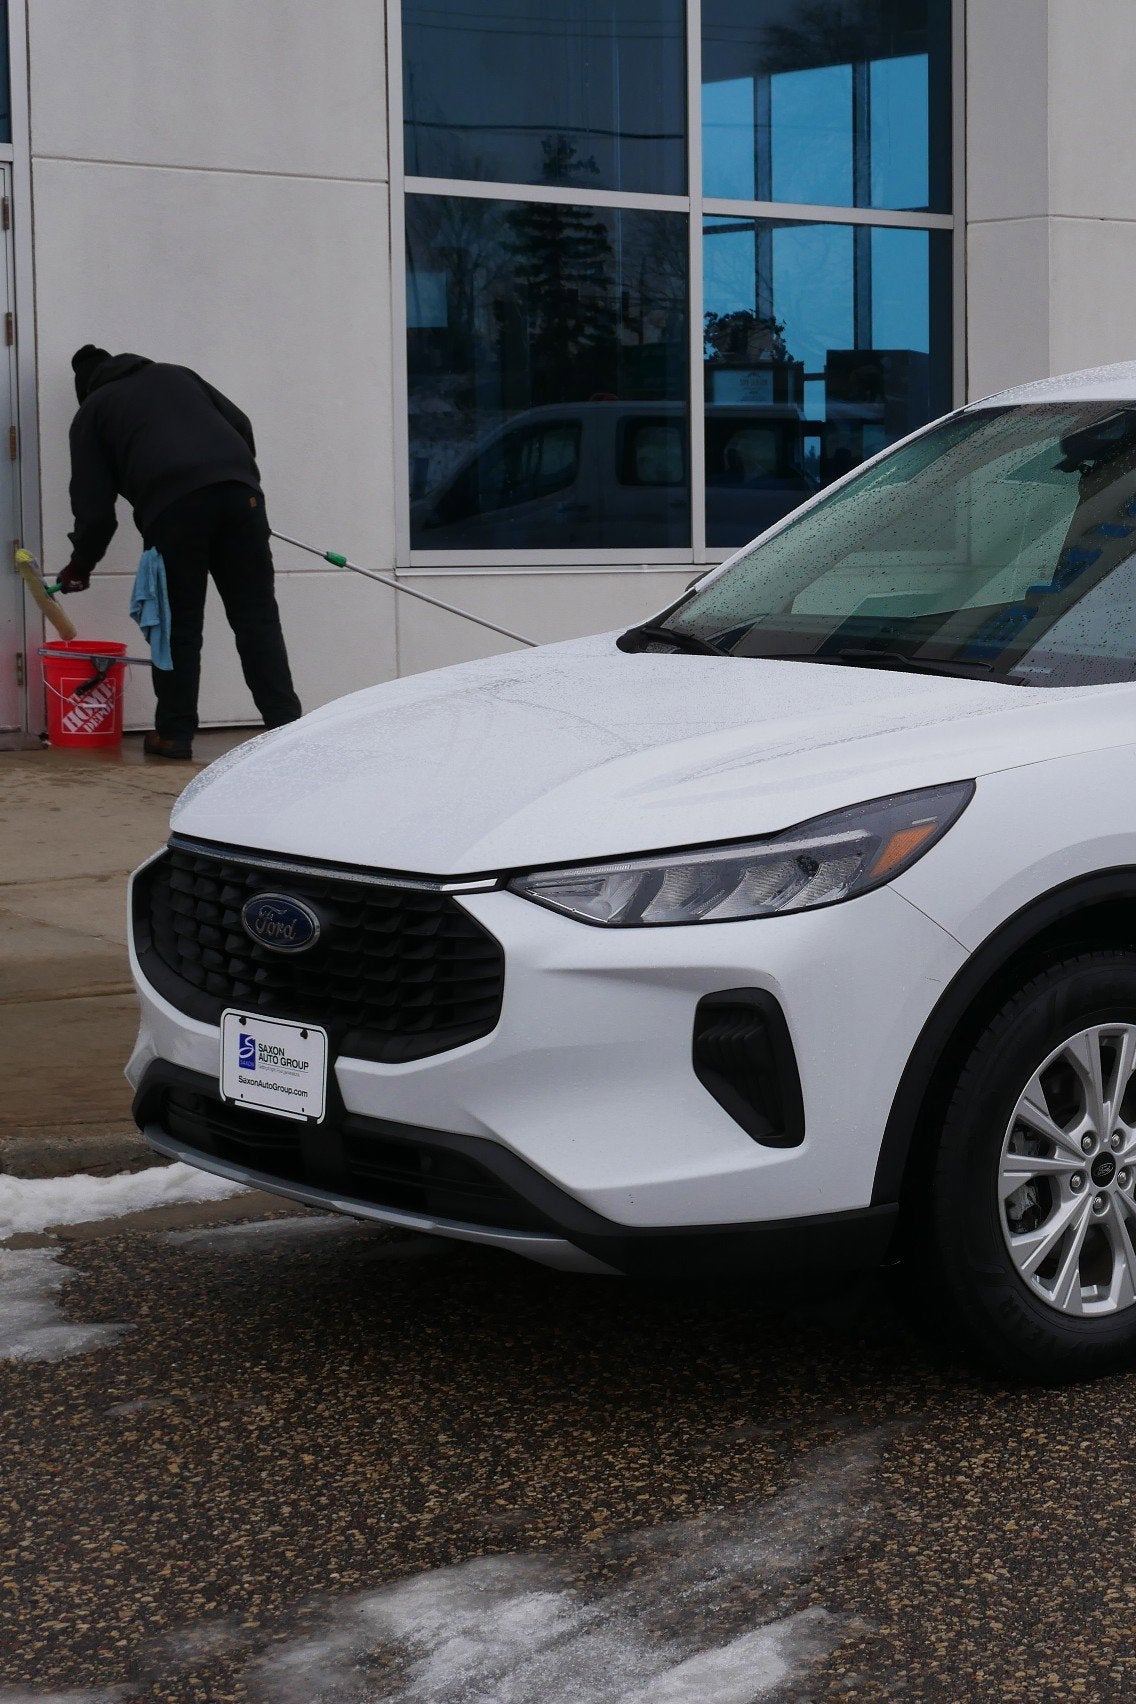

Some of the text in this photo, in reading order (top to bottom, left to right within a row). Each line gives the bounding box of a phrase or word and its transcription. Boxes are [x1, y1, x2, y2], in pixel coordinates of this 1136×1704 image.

[255, 904, 298, 940] Ford
[258, 1043, 285, 1056] SAXON
[259, 1053, 279, 1066] AUTO
[281, 1057, 309, 1071] GROUP
[238, 1075, 308, 1098] SaxonAutoGroup.com
